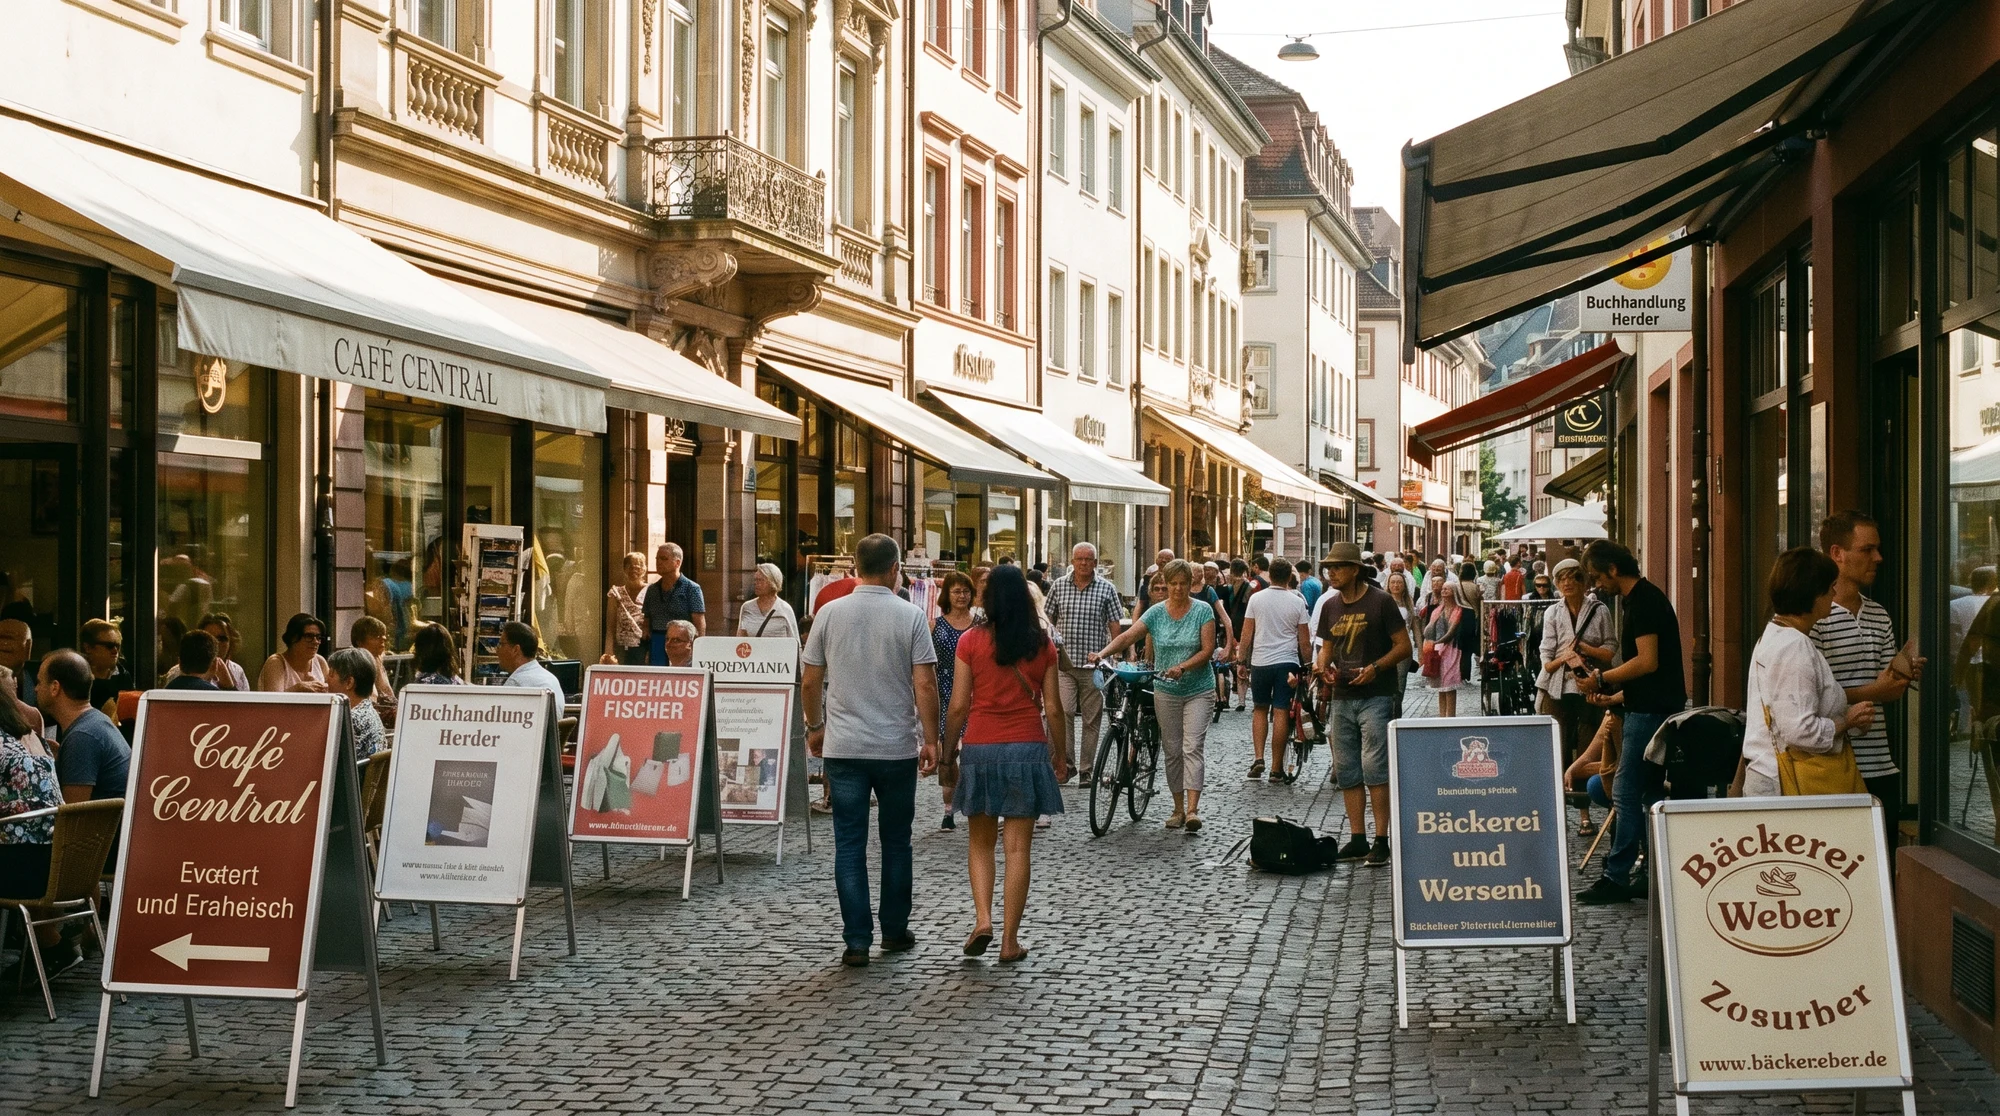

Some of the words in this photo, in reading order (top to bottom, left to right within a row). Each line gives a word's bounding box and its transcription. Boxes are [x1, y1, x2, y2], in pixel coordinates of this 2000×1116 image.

[1586, 295, 1686, 312] Buchhandlung
[1612, 312, 1660, 326] Herder
[334, 337, 395, 384] CAFÉ
[401, 352, 499, 406] CENTRAL
[593, 679, 700, 698] MODEHAUS
[409, 704, 534, 729] Buchhandlung
[604, 701, 684, 720] FISCHER
[438, 729, 500, 747] Herder
[190, 723, 291, 787] Café
[150, 775, 317, 824] Central
[1416, 809, 1541, 834] Bäckerei
[1452, 843, 1507, 867] und
[1680, 823, 1866, 889] Bäckerei
[1418, 877, 1543, 902] Wersenh
[136, 893, 178, 915] und
[186, 894, 294, 919] Eraheisch
[1718, 900, 1841, 931] Weber
